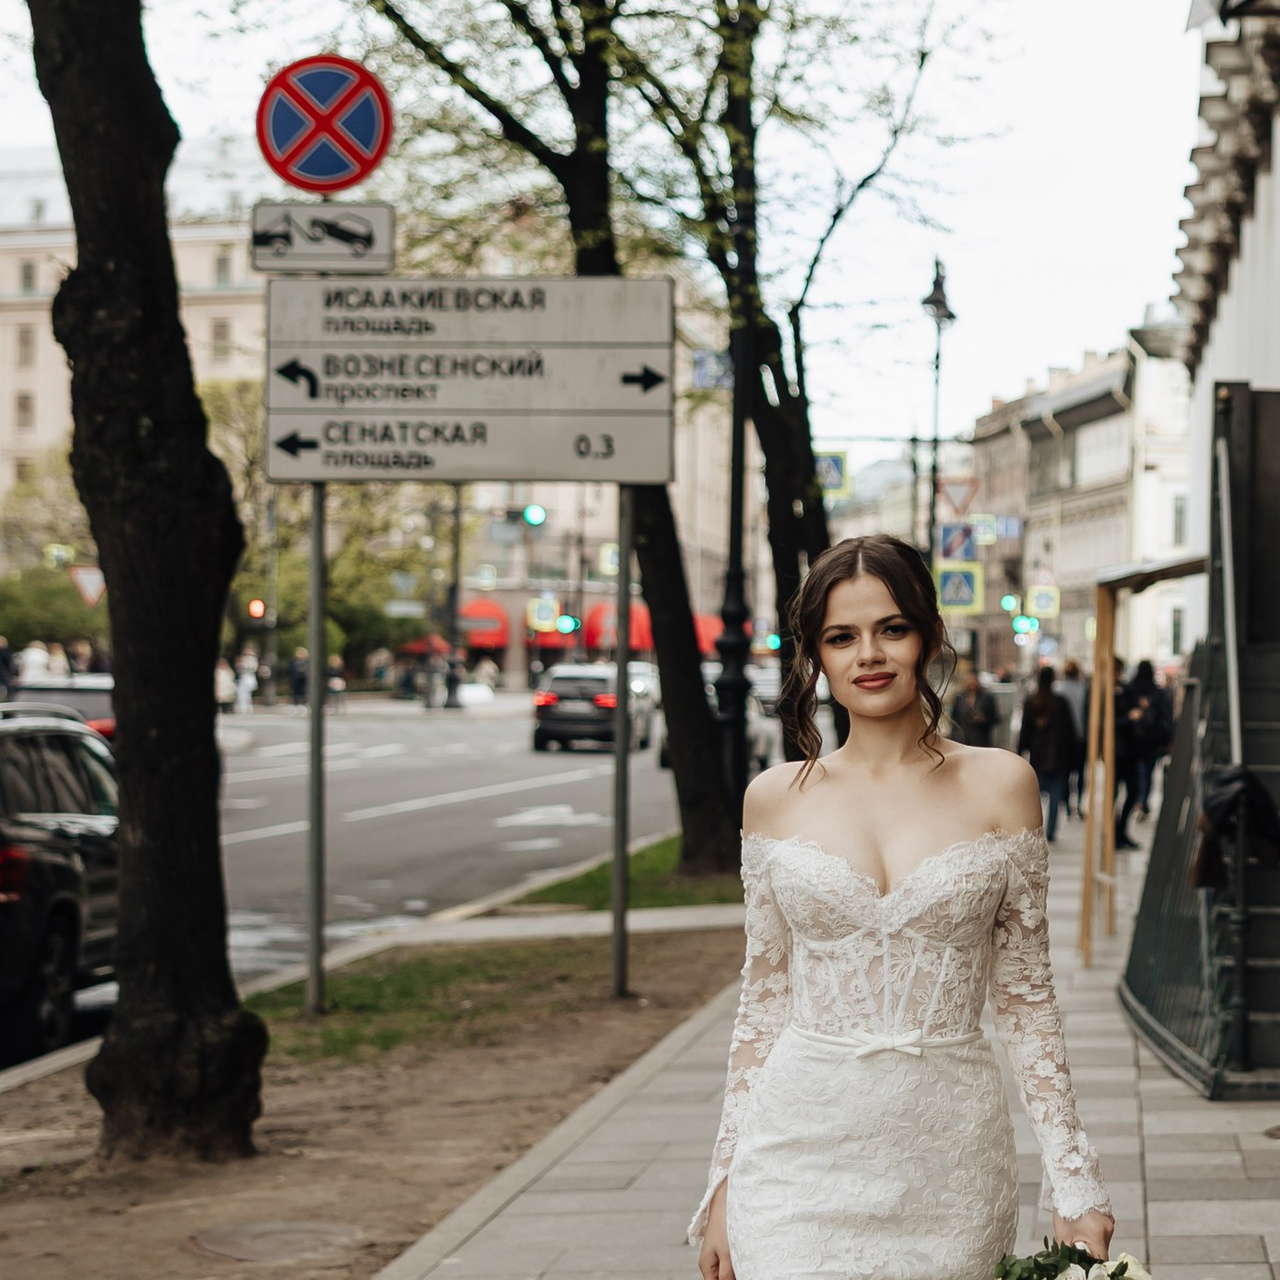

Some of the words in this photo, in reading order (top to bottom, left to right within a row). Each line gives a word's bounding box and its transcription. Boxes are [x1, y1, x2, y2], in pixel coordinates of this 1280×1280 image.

[323, 287, 546, 311] ИСААКИЕВСКАЯ
[323, 316, 437, 337] площадь
[323, 349, 544, 379] ВОЗНЕСЕНСКИЙ
[323, 383, 438, 407] проспект
[323, 420, 488, 446] СЕНАТСКАЯ
[574, 433, 615, 459] 0.3
[323, 450, 437, 470] площадь
